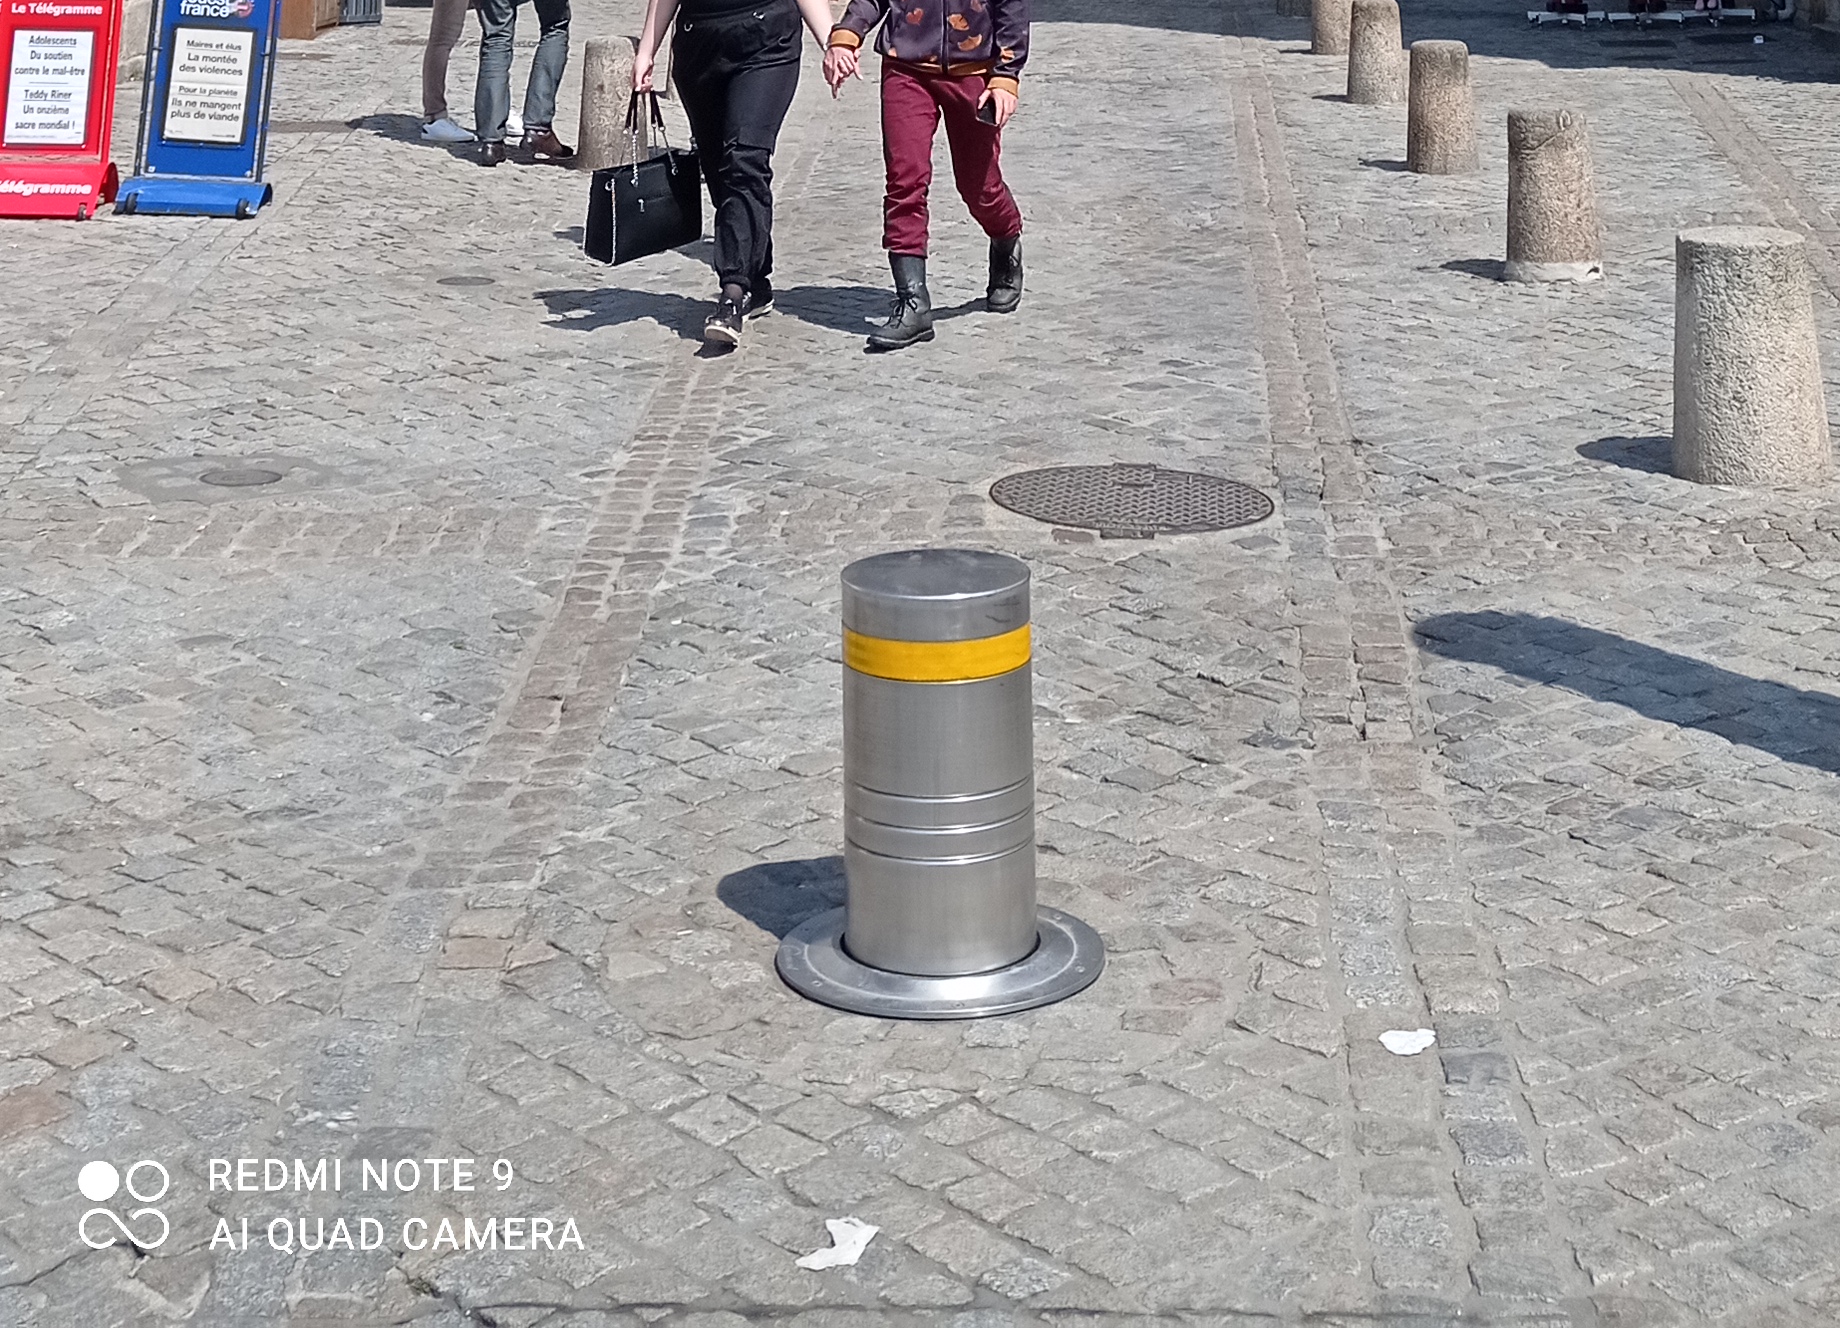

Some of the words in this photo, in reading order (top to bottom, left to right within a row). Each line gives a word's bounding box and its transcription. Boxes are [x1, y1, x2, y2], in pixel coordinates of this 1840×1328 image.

[11, 2, 26, 13] Le
[28, 2, 103, 17] Télégramme
[180, 0, 230, 18] france
[28, 35, 77, 46] Adolescents
[186, 40, 213, 48] Maires
[225, 42, 242, 51] élus
[30, 50, 41, 60] Du
[44, 51, 73, 61] soutien
[187, 52, 200, 61] La
[201, 55, 238, 64] montée
[14, 67, 40, 75] contre
[42, 66, 50, 75] le
[52, 66, 85, 76] mal-être
[178, 63, 197, 73] des
[198, 65, 243, 76] violences
[24, 89, 48, 101] Teddy
[50, 90, 72, 100] Riner
[178, 85, 198, 94] Pour
[208, 88, 238, 97] planète
[23, 104, 35, 114] Un
[36, 104, 70, 115] onzième
[171, 97, 183, 107] Ils
[184, 100, 198, 108] ne
[199, 101, 242, 112] mangent
[170, 109, 192, 119] plus
[193, 110, 206, 120] de
[208, 111, 240, 122] viande
[14, 121, 36, 130] sacre
[38, 119, 70, 130] mondial
